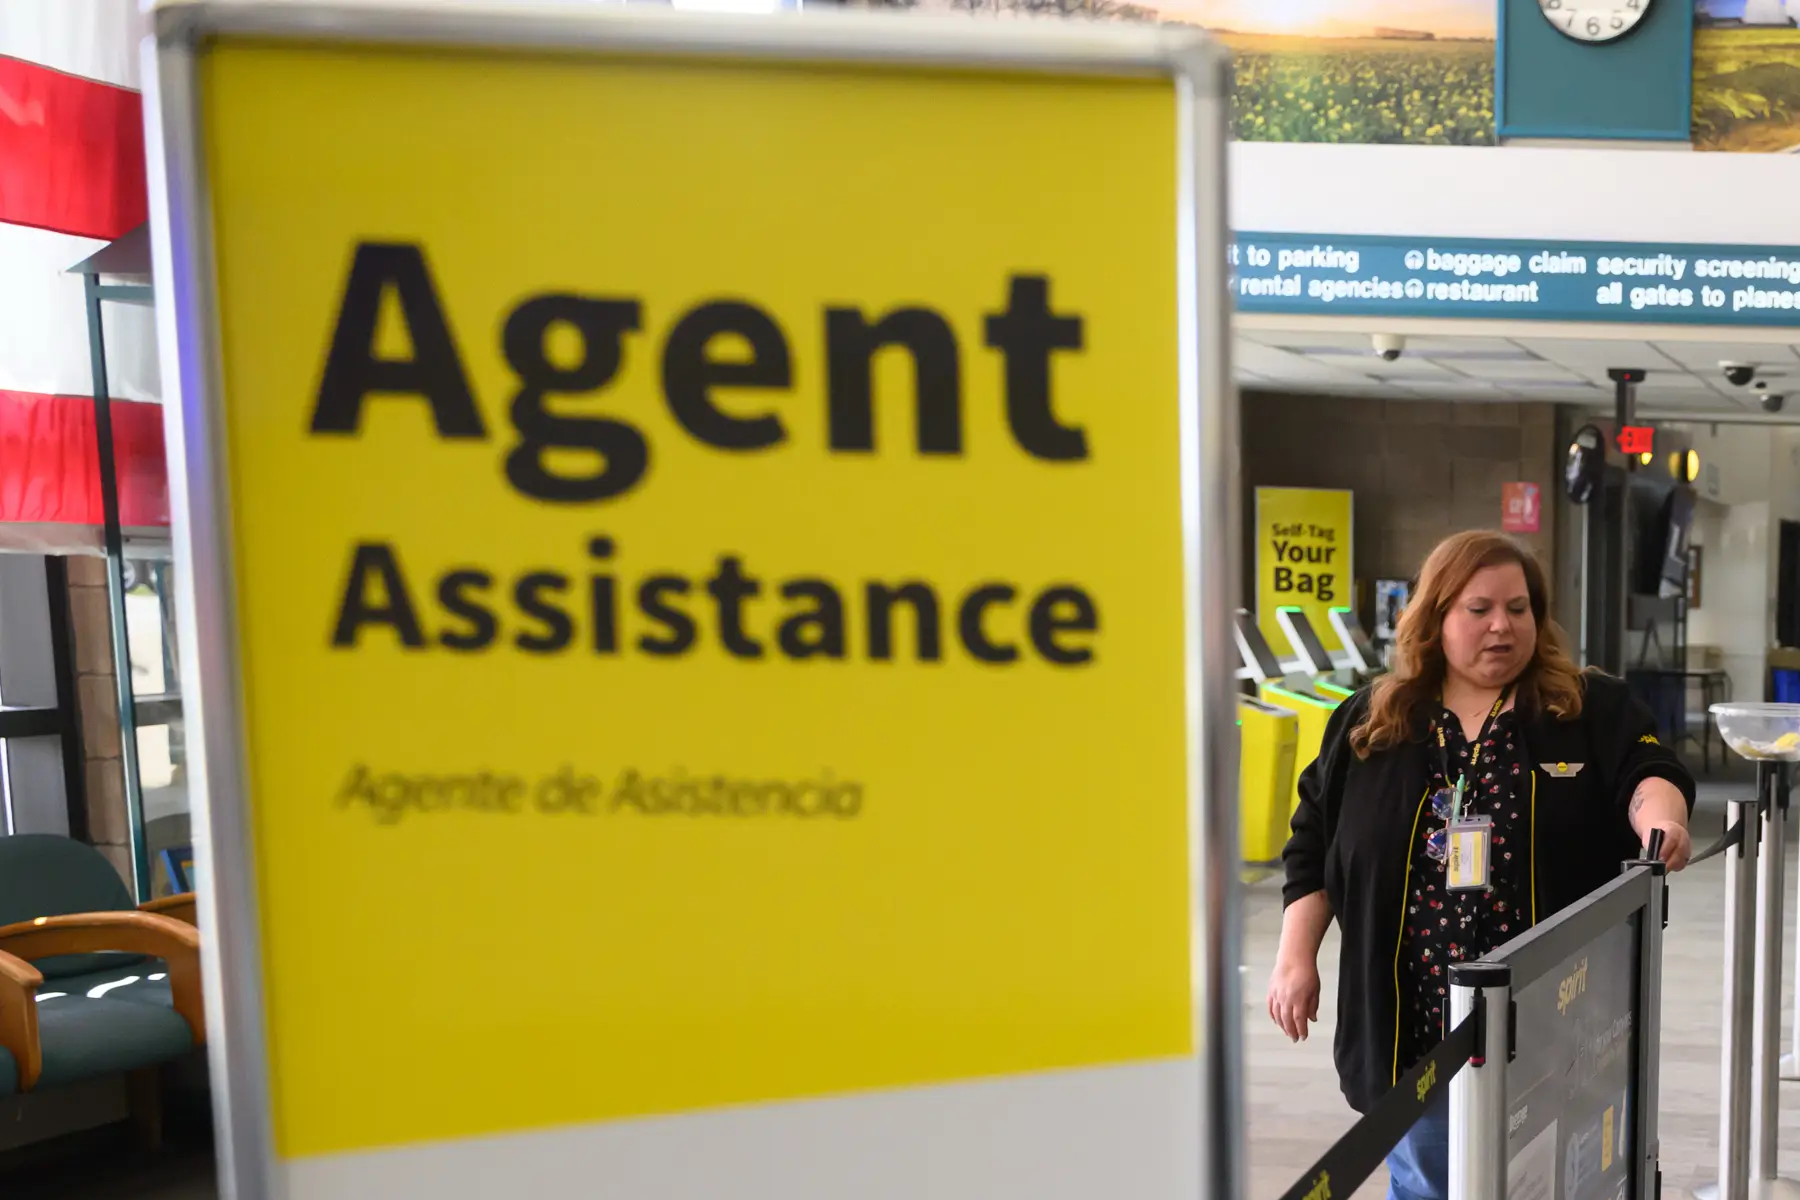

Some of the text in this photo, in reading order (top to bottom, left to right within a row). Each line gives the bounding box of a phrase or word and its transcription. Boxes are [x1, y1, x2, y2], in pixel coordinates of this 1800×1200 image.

[1247, 245, 1271, 267] to
[1278, 245, 1360, 273] parking
[1426, 248, 1586, 277] baggage claim
[1596, 254, 1686, 280] security
[1240, 274, 1302, 296] rental
[1307, 276, 1404, 302] agencies
[1426, 279, 1539, 303] restaurant
[1596, 282, 1623, 305] all
[1629, 285, 1694, 309] gates
[1701, 285, 1726, 307] to
[308, 239, 1092, 505] Agent
[1272, 540, 1336, 564] Your
[1274, 566, 1335, 602] Bag
[332, 533, 1101, 667] Assistance
[333, 765, 863, 826] Agente de Asistencia
[1557, 956, 1589, 1017] spirit
[1416, 1060, 1437, 1103] spirit
